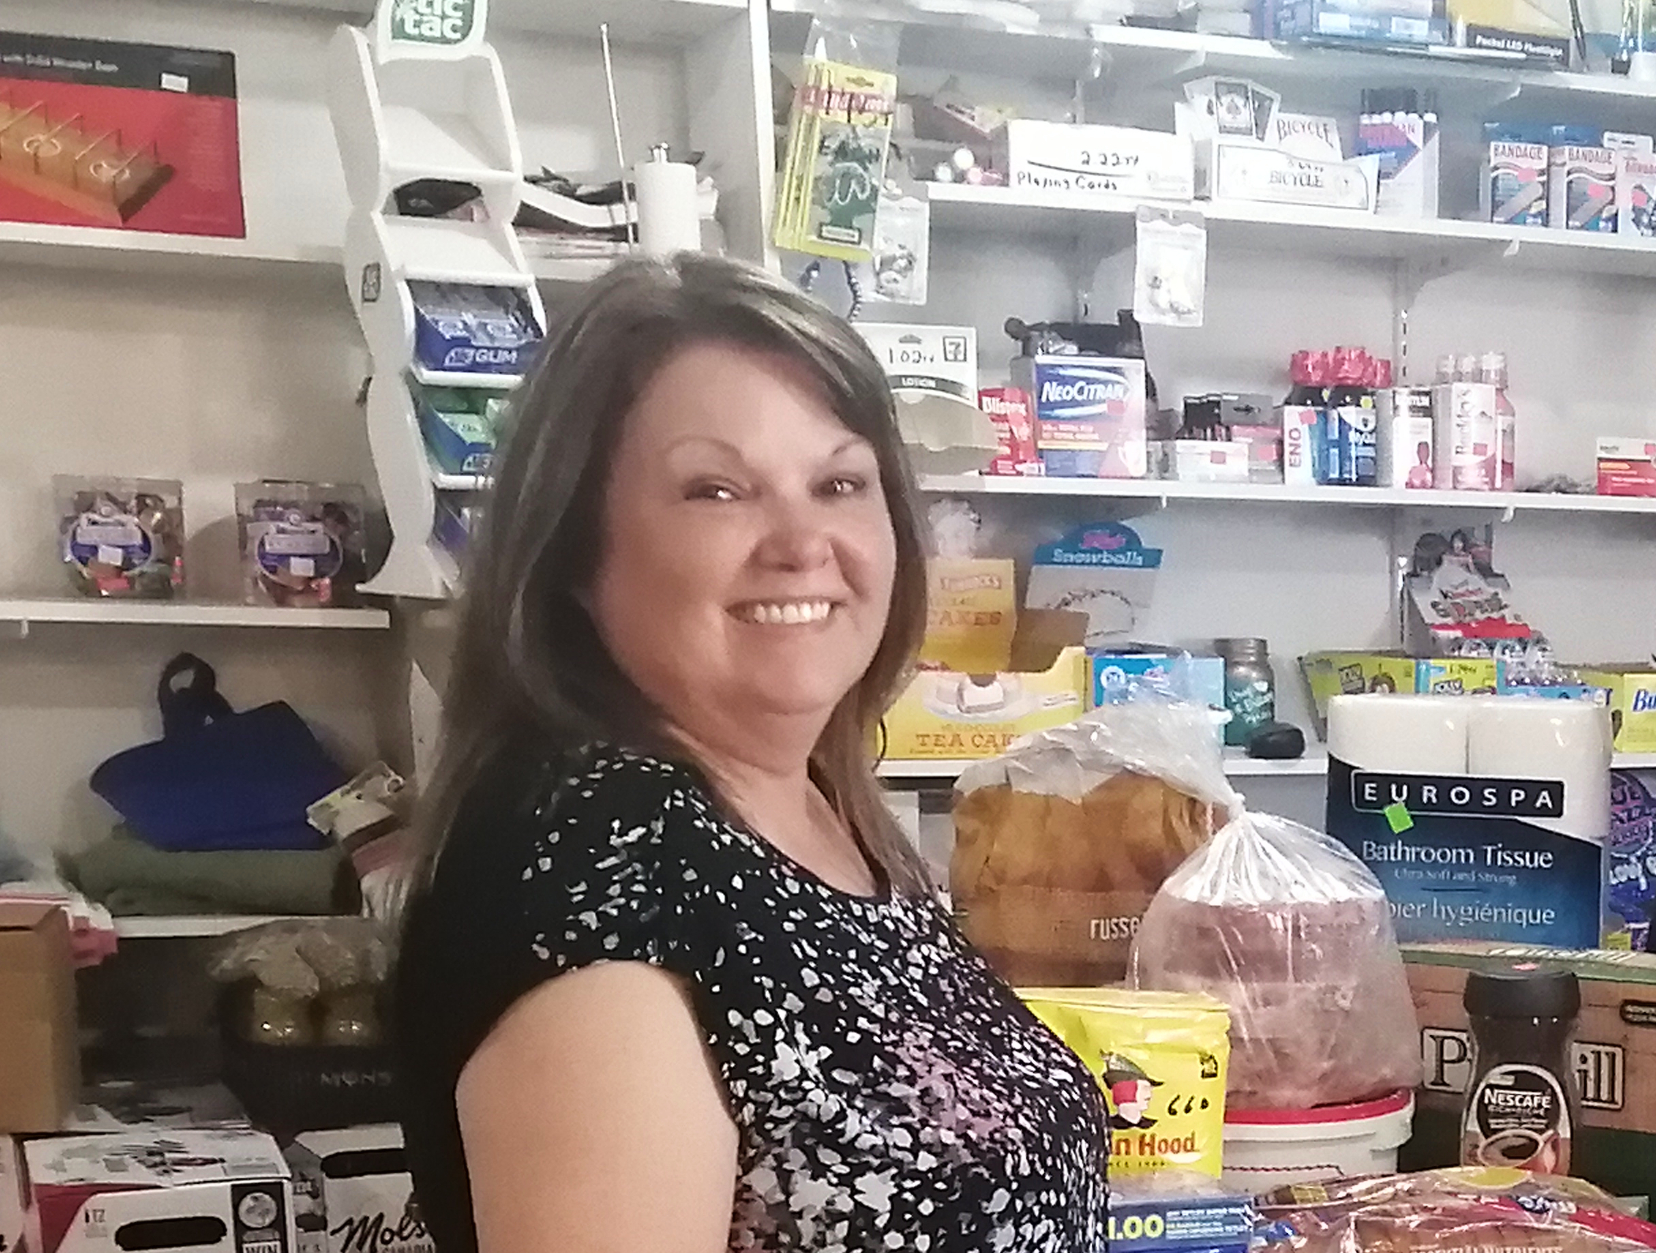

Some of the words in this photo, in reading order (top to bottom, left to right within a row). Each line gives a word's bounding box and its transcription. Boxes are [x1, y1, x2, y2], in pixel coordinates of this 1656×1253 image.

[403, 11, 464, 39] tac
[1275, 118, 1334, 148] BICYCLE
[1493, 143, 1545, 161] BANDAGE
[1568, 147, 1613, 165] BANDAGE
[1017, 171, 1071, 189] Playing
[1268, 170, 1325, 188] BICYCLE
[475, 348, 518, 365] GUM
[1289, 427, 1303, 469] ENO
[1052, 548, 1143, 566] Snowballs
[915, 733, 965, 749] TEA
[1363, 782, 1554, 810] EUROSPA
[1362, 840, 1475, 866] Bathroom
[1484, 843, 1555, 870] Tissue
[1425, 868, 1452, 881] Soft
[1452, 869, 1476, 882] and
[1477, 871, 1518, 888] Strong
[1431, 895, 1556, 929] hygiénique
[1138, 1129, 1197, 1156] Hood
